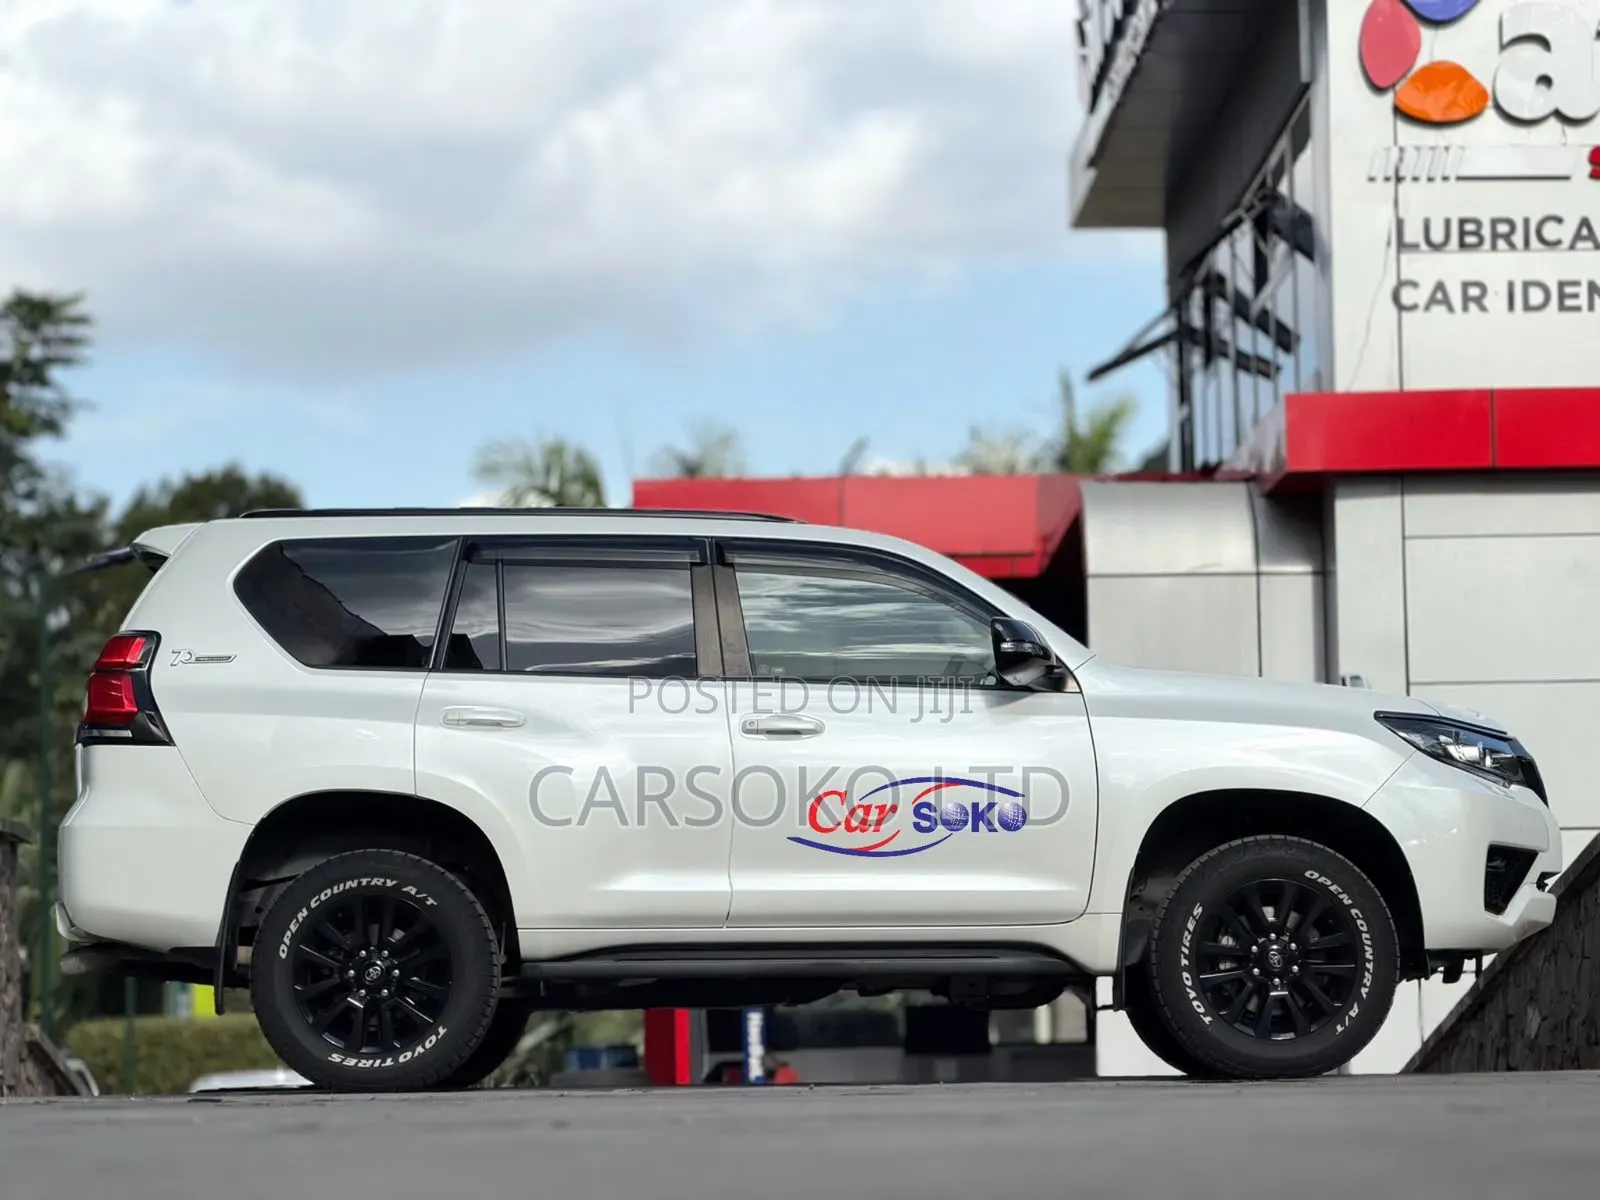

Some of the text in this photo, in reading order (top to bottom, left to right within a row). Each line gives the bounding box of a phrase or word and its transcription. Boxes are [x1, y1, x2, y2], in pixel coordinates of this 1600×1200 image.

[1492, 2, 1600, 126] a
[1397, 215, 1600, 250] LUBRICA
[1392, 279, 1489, 313] CAR
[808, 790, 1027, 834] Car SOKO
[279, 877, 438, 960] OPEN COUNTRY A/T
[1181, 902, 1213, 1026] TOYO TIRES
[1304, 870, 1374, 1036] OPEN COUNTRY A/T
[327, 1025, 447, 1068] TOYO TIRES
